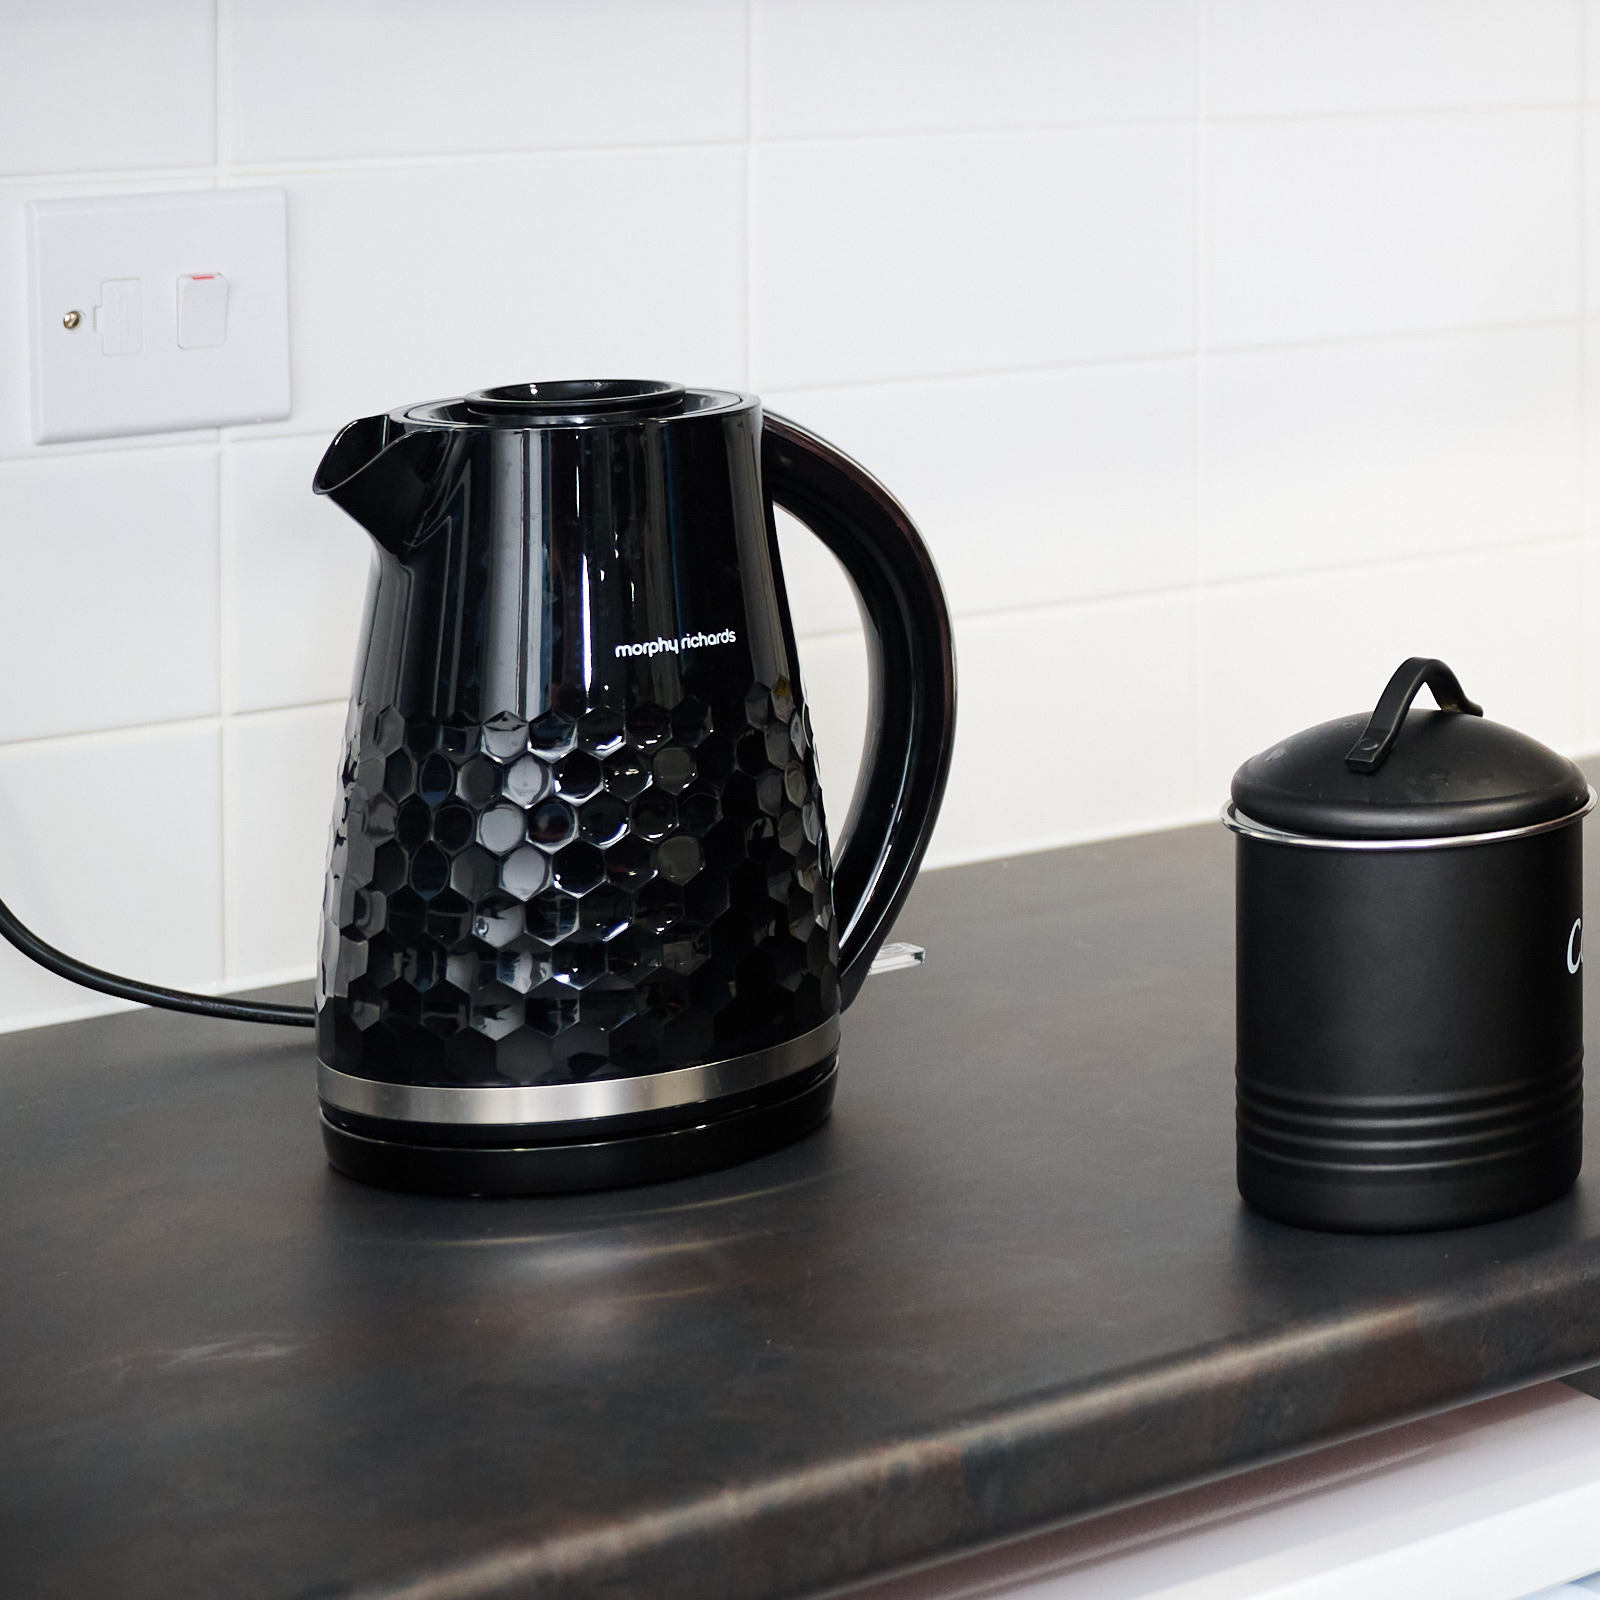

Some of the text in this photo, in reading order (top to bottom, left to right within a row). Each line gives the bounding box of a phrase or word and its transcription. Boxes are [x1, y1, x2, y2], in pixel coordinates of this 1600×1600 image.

[615, 628, 737, 658] morphy richards
[1566, 917, 1583, 975] C
